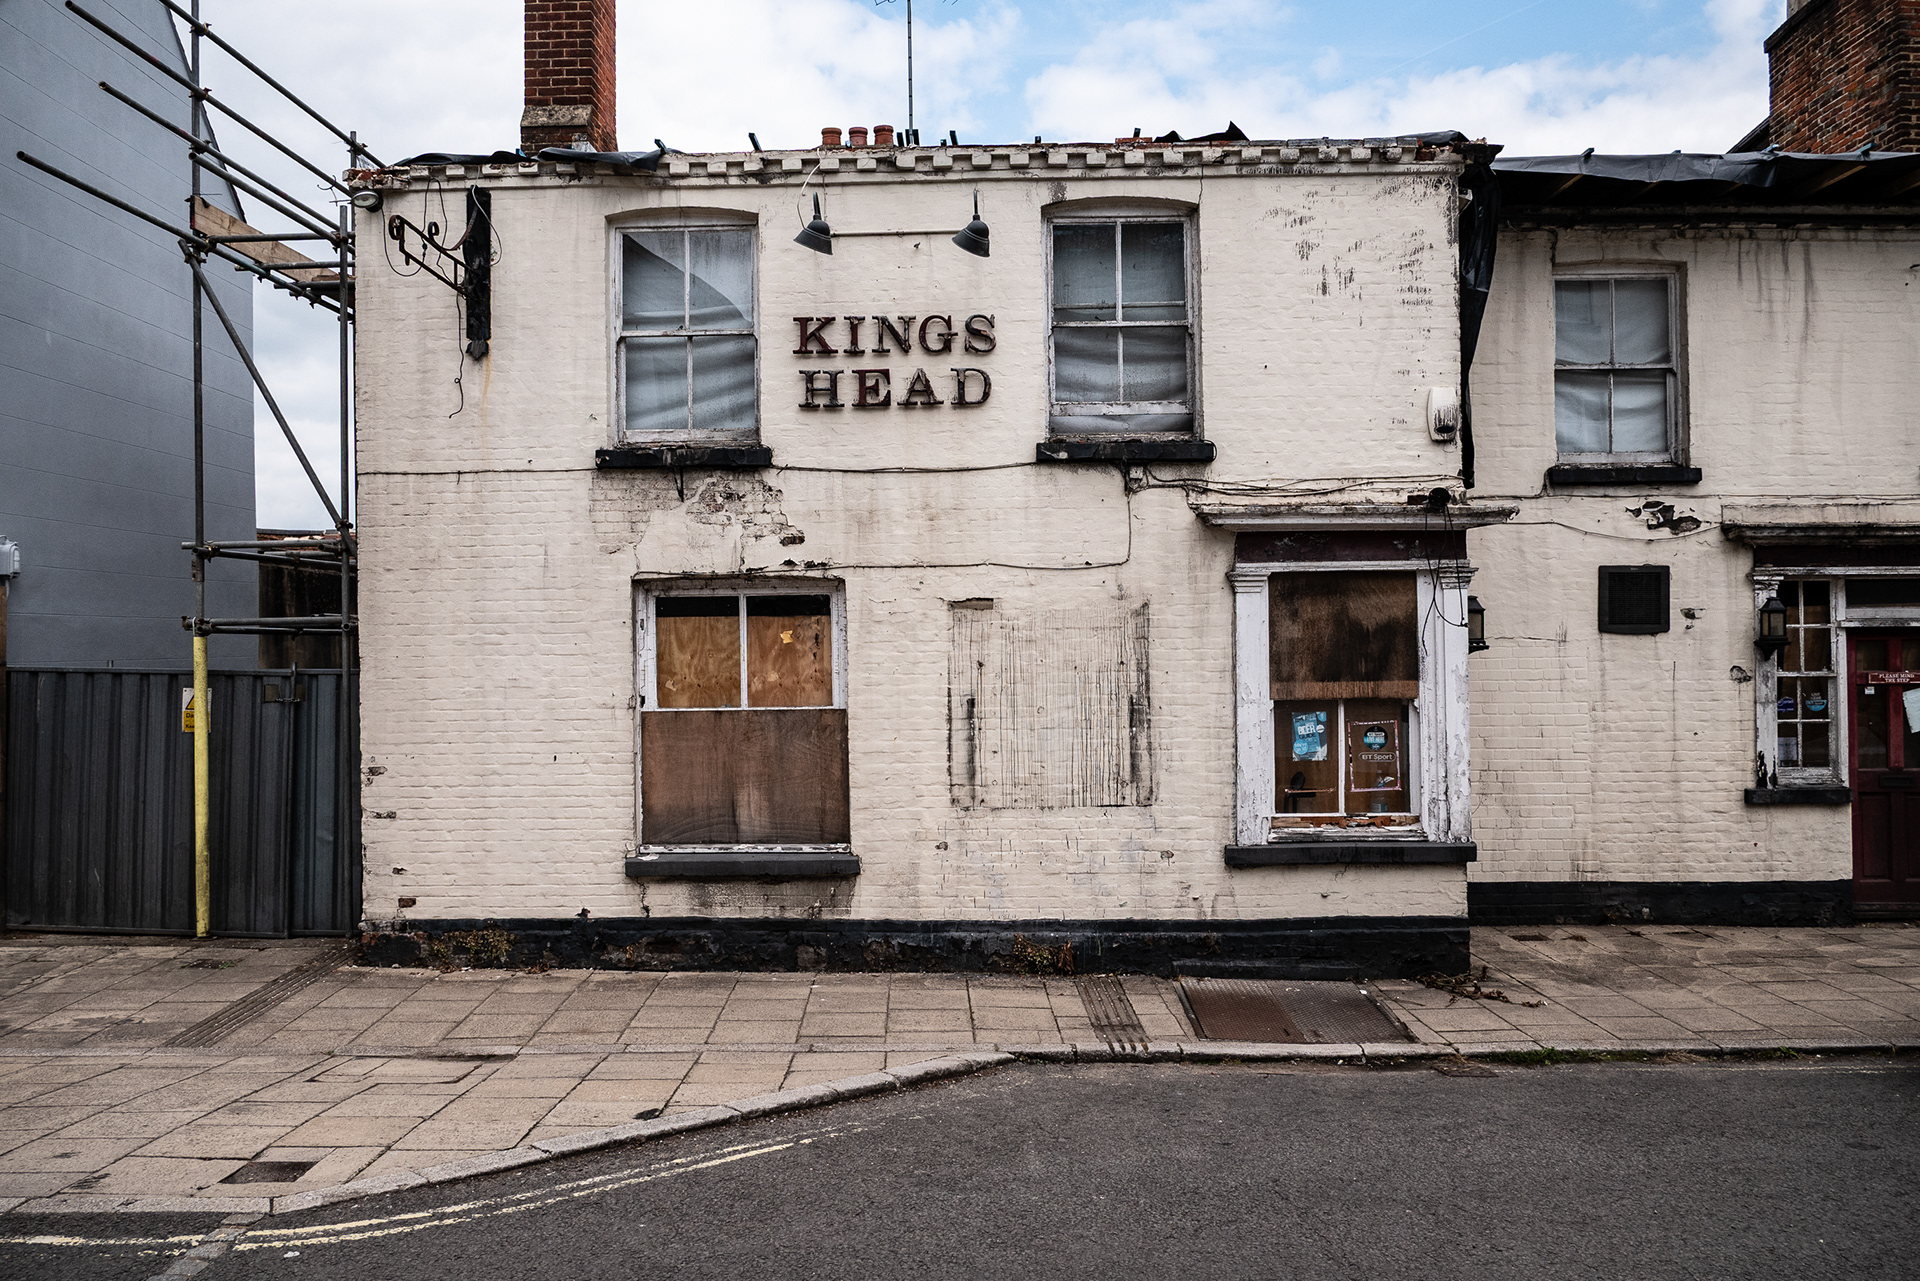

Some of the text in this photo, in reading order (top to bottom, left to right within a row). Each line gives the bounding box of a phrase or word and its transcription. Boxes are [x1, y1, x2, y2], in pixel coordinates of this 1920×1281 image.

[793, 314, 997, 354] KINGS
[798, 368, 992, 407] HEAD
[1297, 725, 1316, 735] BEER
[1373, 753, 1393, 761] Sport
